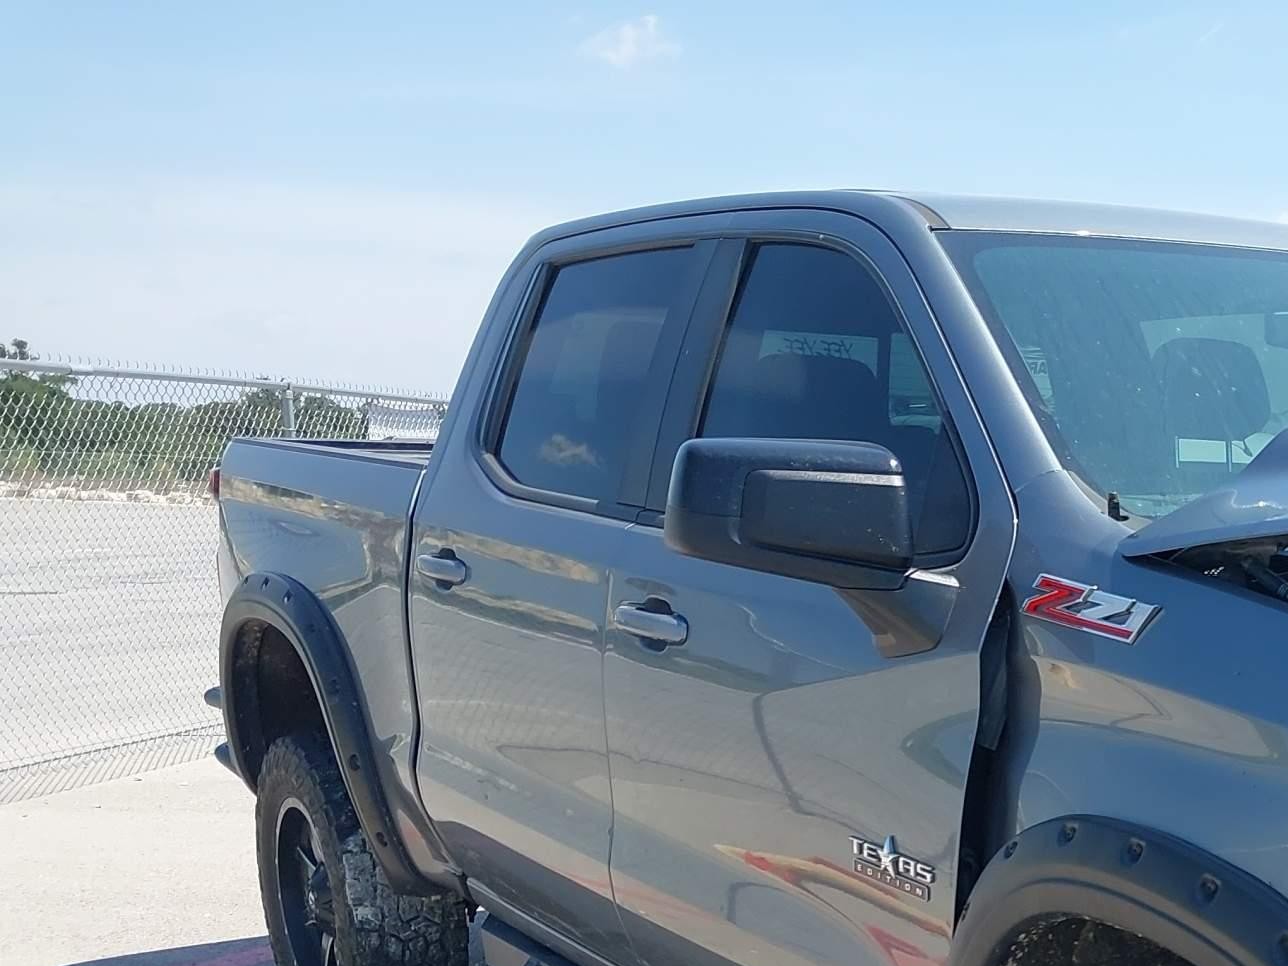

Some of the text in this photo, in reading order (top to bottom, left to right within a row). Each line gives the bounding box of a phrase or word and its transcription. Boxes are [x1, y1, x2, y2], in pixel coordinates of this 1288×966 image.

[1020, 573, 1163, 645] Z71
[848, 834, 936, 883] TEXAS
[855, 864, 924, 897] EDITION
